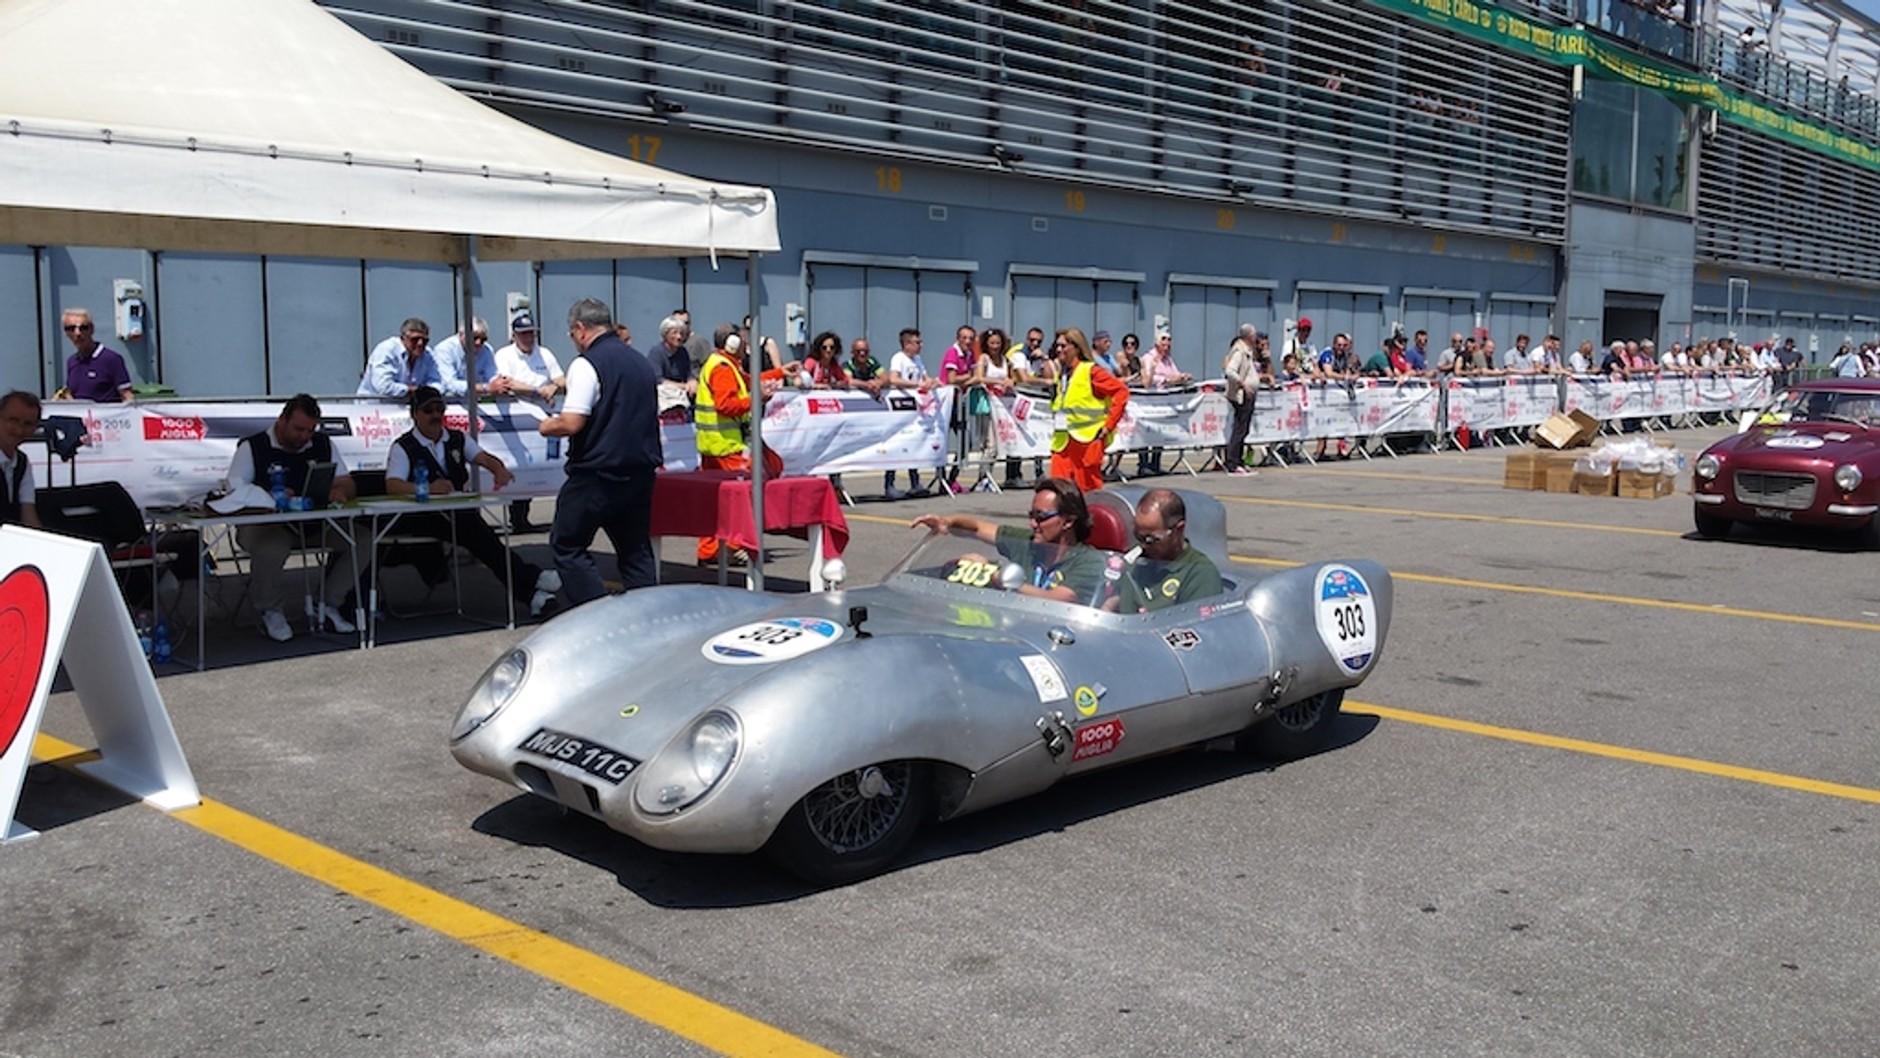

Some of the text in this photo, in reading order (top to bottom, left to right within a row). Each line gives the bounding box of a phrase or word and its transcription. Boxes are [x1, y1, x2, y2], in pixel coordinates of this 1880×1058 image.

[627, 135, 662, 163] 17
[875, 166, 902, 193] 18
[1064, 191, 1086, 213] 19
[161, 418, 194, 429] 1000
[946, 559, 999, 588] 303
[738, 626, 802, 645] 303
[1334, 603, 1366, 641] 303
[1081, 724, 1114, 743] 1000
[525, 731, 635, 780] MJS 11C
